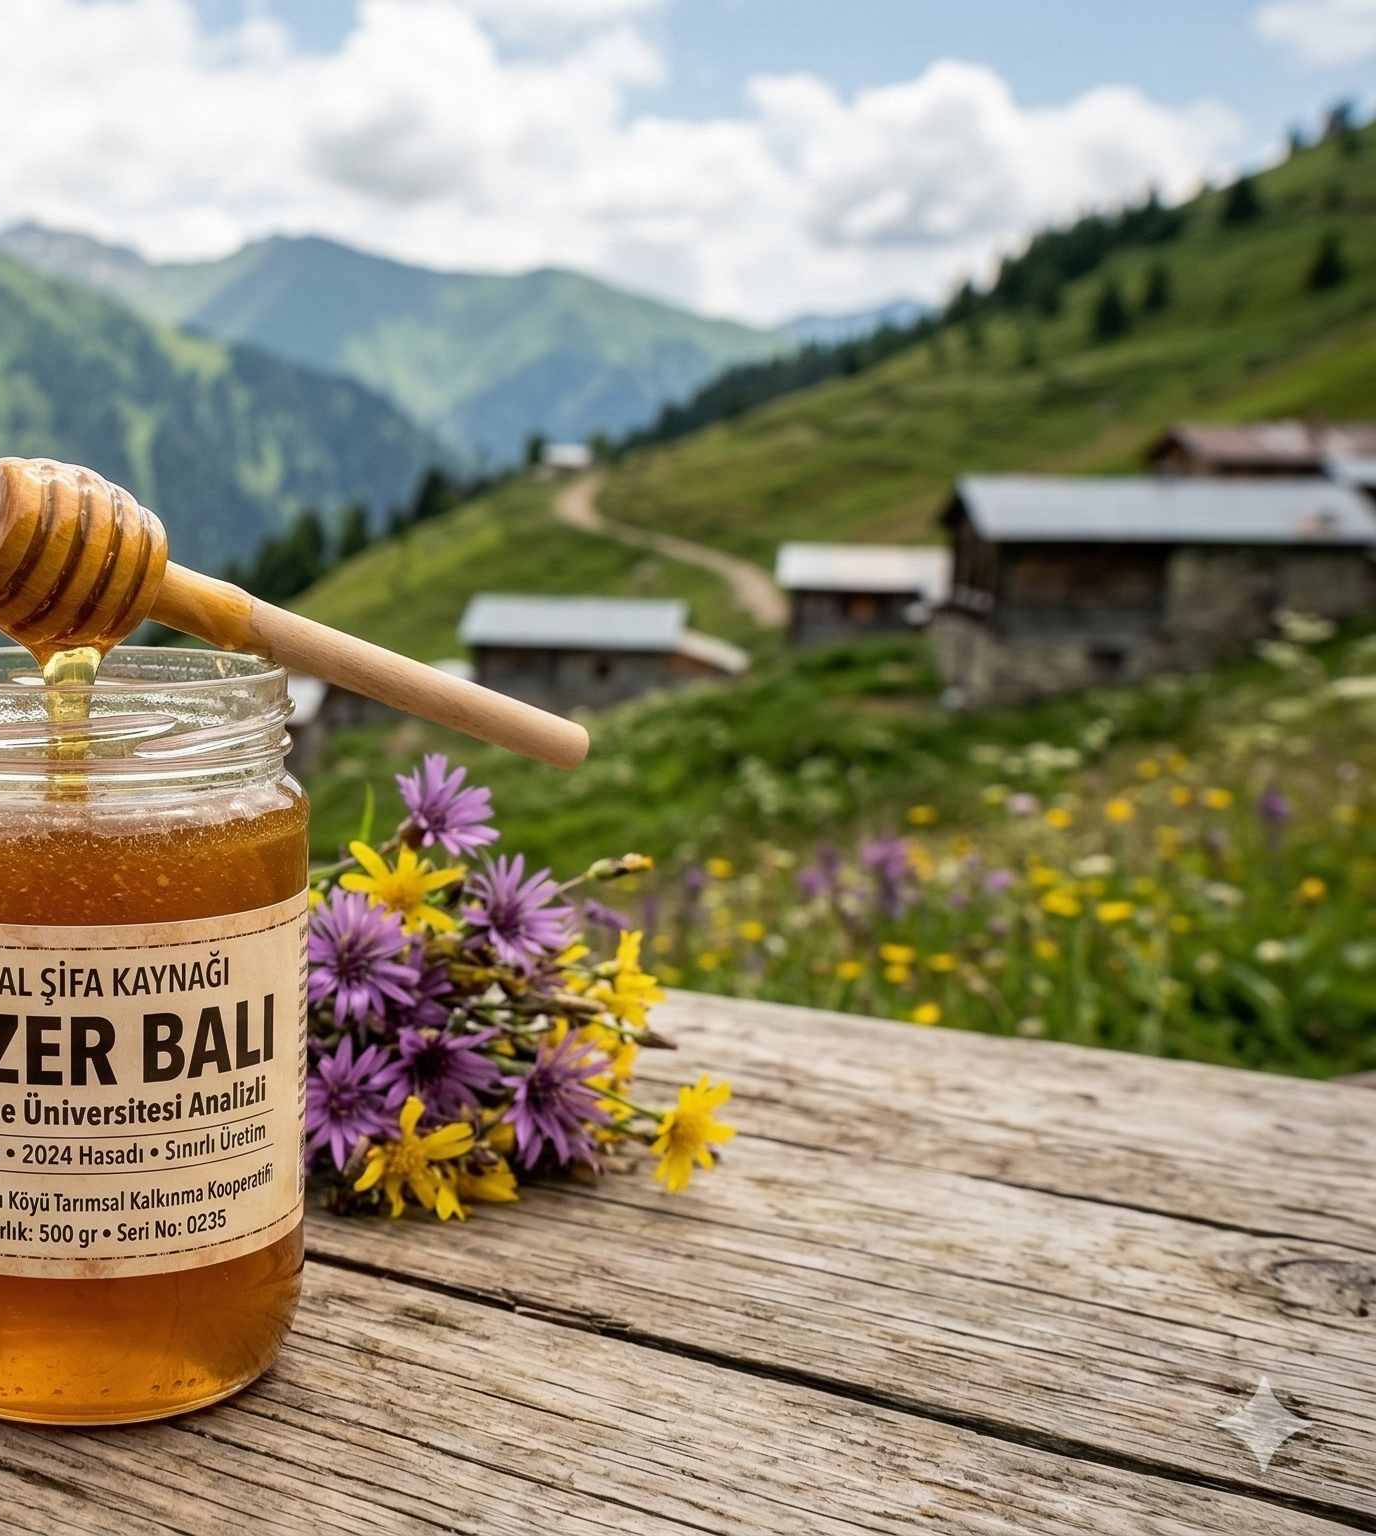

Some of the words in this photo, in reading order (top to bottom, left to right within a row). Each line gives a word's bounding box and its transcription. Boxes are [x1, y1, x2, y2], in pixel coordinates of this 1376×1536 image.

[39, 960, 105, 1007] ŞİFA
[112, 949, 230, 997] KAYNAĞI
[142, 992, 275, 1084] BALI
[23, 1091, 183, 1127] Üniversitesi
[187, 1074, 266, 1119] Analizli
[21, 1143, 73, 1166] 2024
[79, 1142, 144, 1166] Hasadı
[165, 1133, 215, 1161] Sınırlı
[220, 1123, 266, 1151] Üretim
[8, 1190, 50, 1217] Köyü
[53, 1190, 125, 1213] Tarımsal
[130, 1187, 204, 1211] Kalkınma
[38, 1223, 74, 1244] 500
[78, 1228, 99, 1249] gr
[116, 1221, 150, 1243] Seri
[154, 1219, 182, 1240] No:
[186, 1208, 227, 1235] 0235
